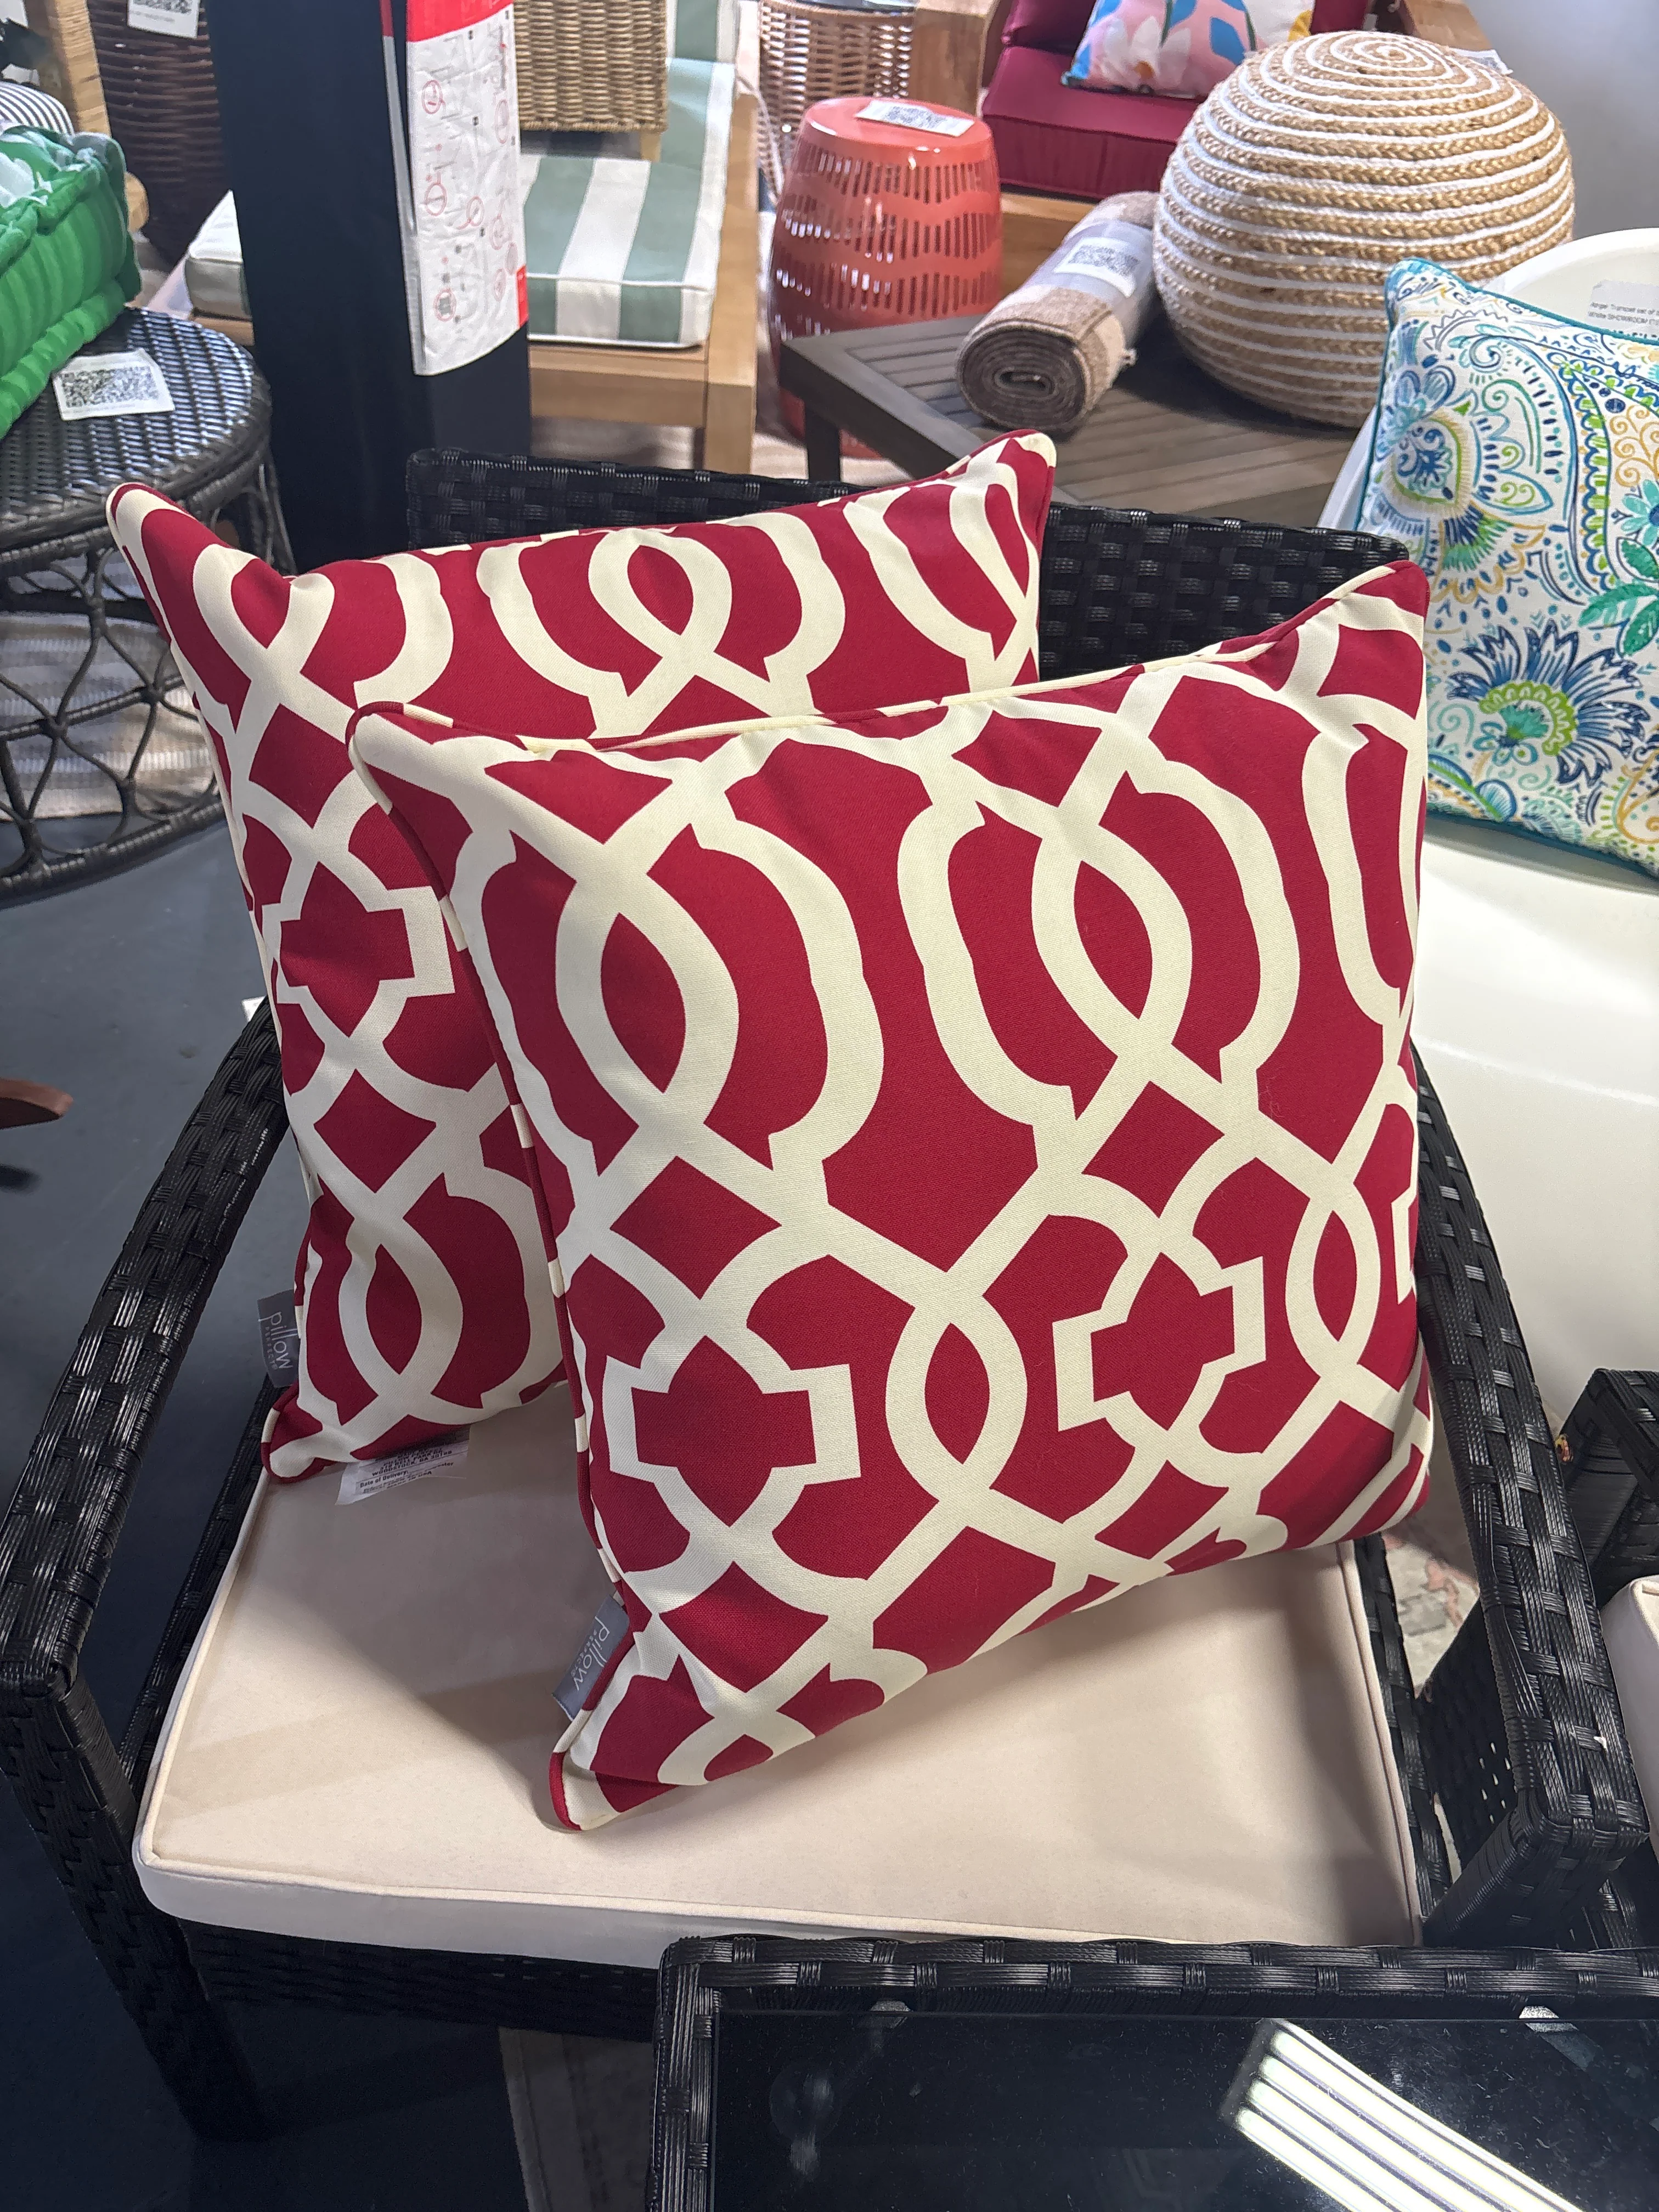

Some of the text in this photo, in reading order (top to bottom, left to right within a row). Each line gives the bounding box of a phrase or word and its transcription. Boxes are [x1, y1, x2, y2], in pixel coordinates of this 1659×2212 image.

[258, 1311, 298, 1369] pillow
[360, 1480, 374, 1488] Date
[573, 1616, 610, 1691] pillow
